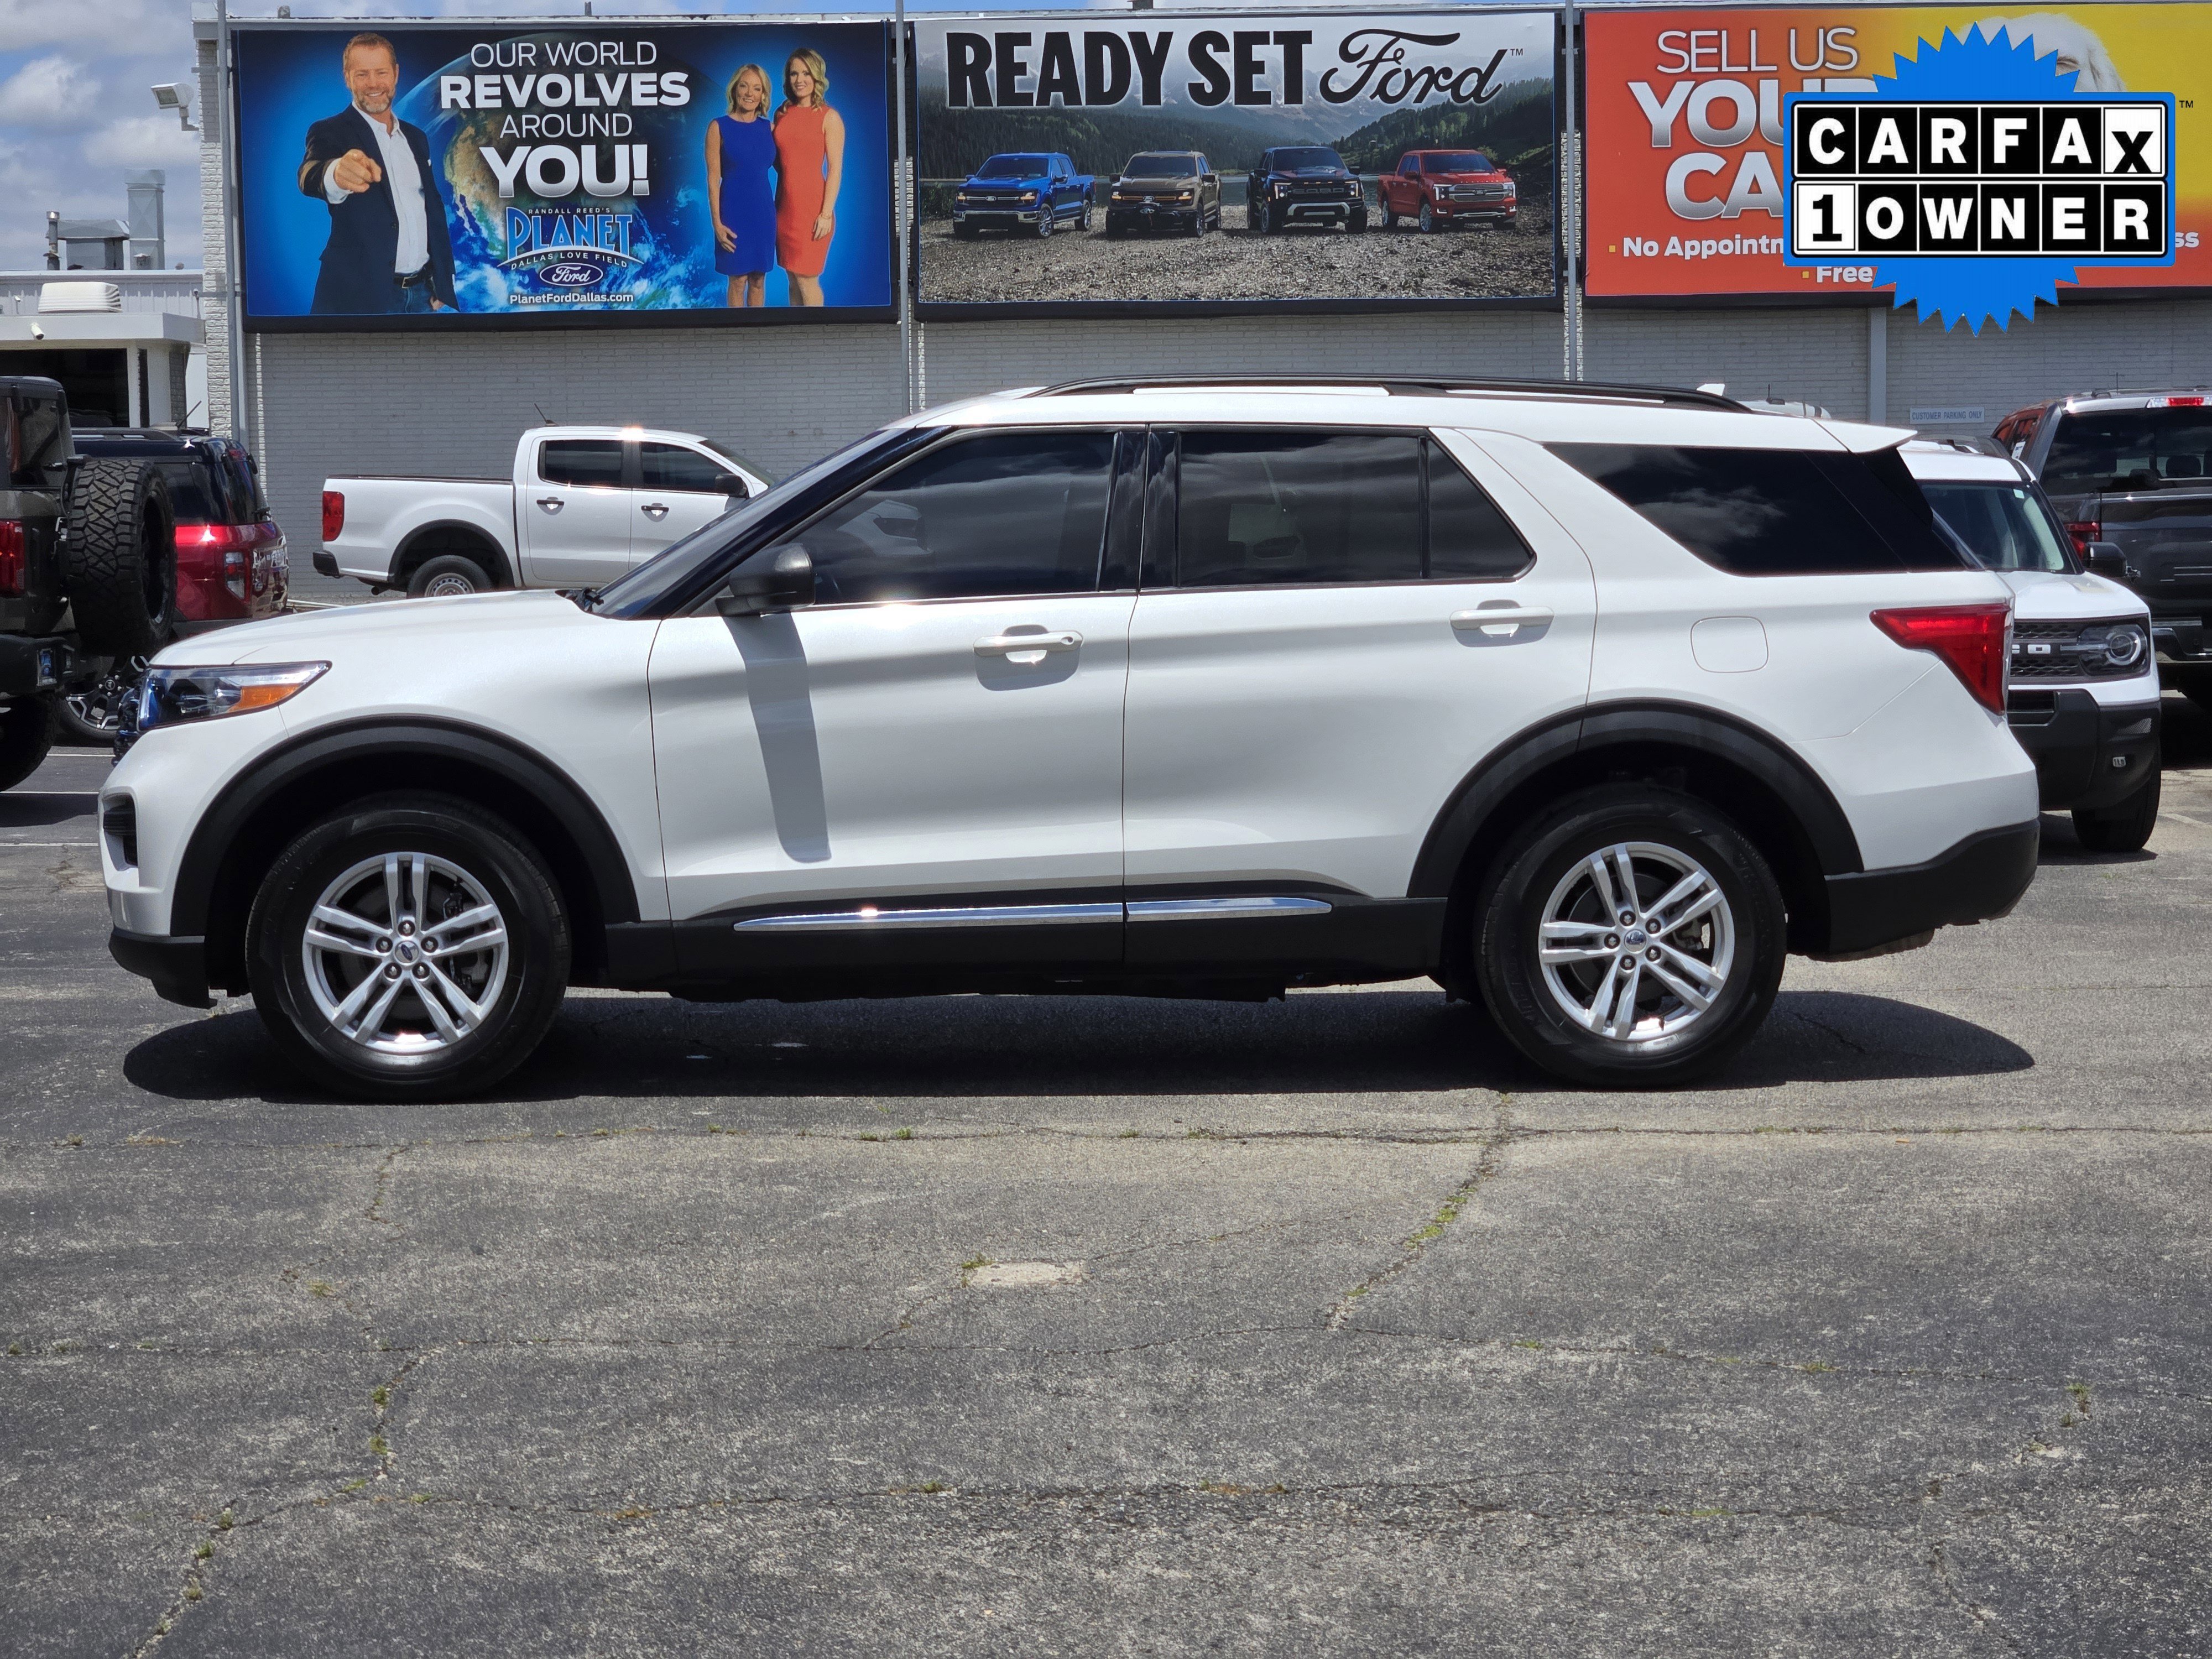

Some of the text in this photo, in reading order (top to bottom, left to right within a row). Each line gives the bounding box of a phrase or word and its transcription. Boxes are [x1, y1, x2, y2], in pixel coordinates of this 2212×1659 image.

[470, 41, 656, 67] OUR WORLD
[1657, 28, 1858, 73] SELL US
[947, 31, 1173, 107] READY
[1187, 30, 1312, 106] SET
[1319, 29, 1507, 104] Ford
[441, 72, 691, 109] REVOLVES
[499, 113, 632, 138] AROUND
[479, 145, 650, 197] YOU!
[1666, 152, 1784, 220] CA
[506, 206, 633, 260] PLANET
[1623, 237, 1658, 257] No
[511, 253, 554, 270] DALLAS
[595, 254, 627, 268] FIELD
[551, 265, 591, 283] Ford
[1817, 267, 1873, 283] Free
[510, 293, 634, 304] PlanetFordDallas.com
[1912, 411, 1941, 420] CUSTOMER
